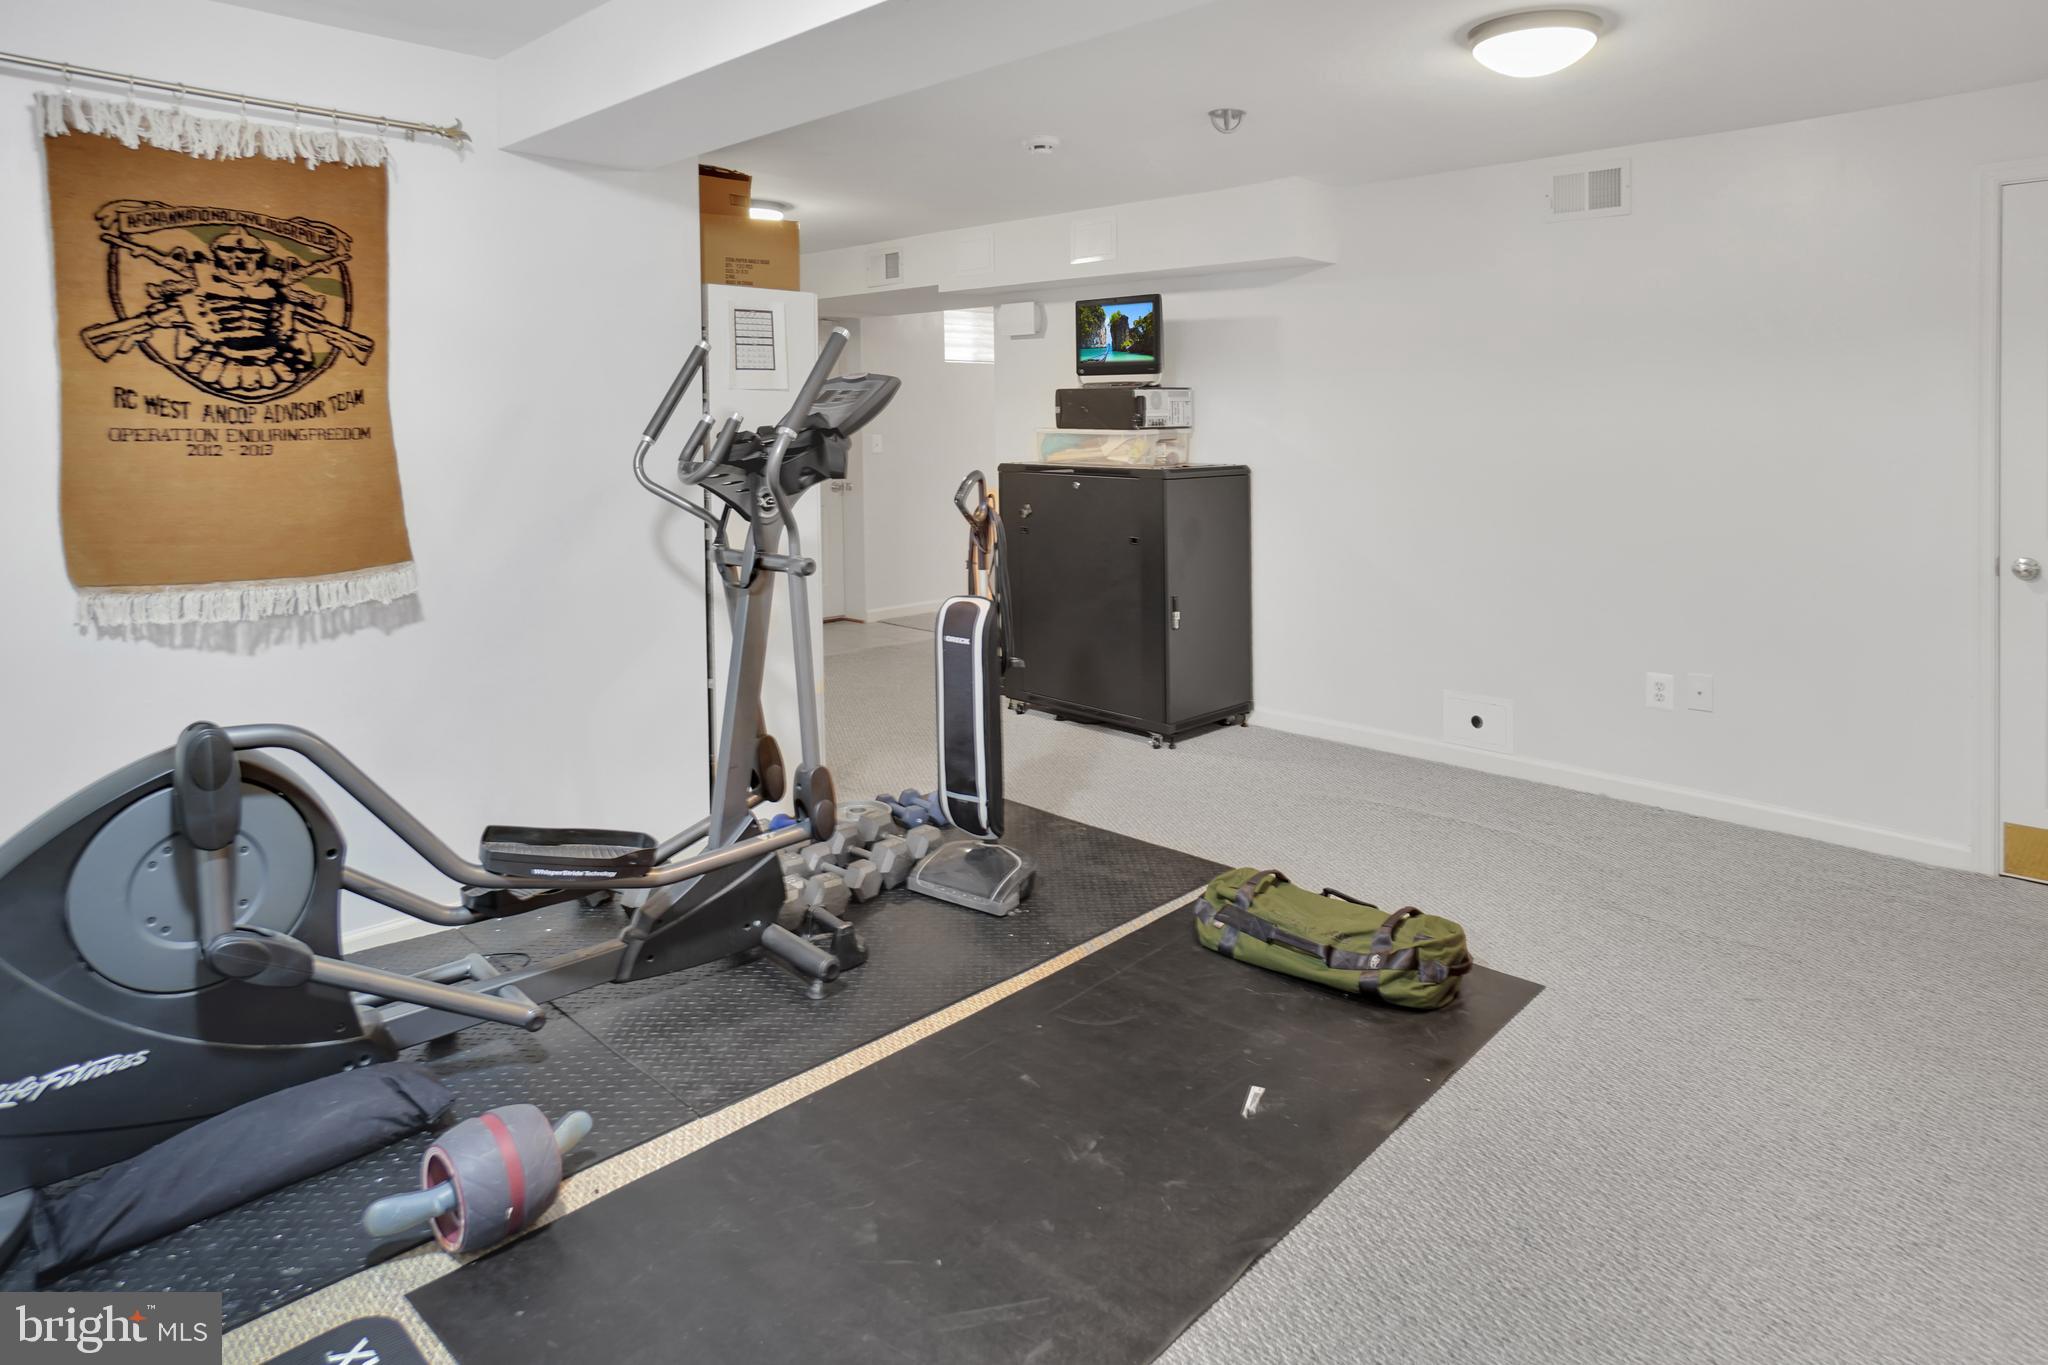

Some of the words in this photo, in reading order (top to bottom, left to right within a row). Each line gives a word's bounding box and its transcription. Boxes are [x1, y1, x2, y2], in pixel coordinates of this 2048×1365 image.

[143, 394, 192, 420] WEST
[201, 404, 257, 424] ANCOP
[263, 400, 328, 423] ADVISOR
[328, 388, 365, 415] TEAM
[107, 427, 219, 442] OPERATION
[186, 443, 223, 457] 2012
[239, 444, 273, 457] 2013
